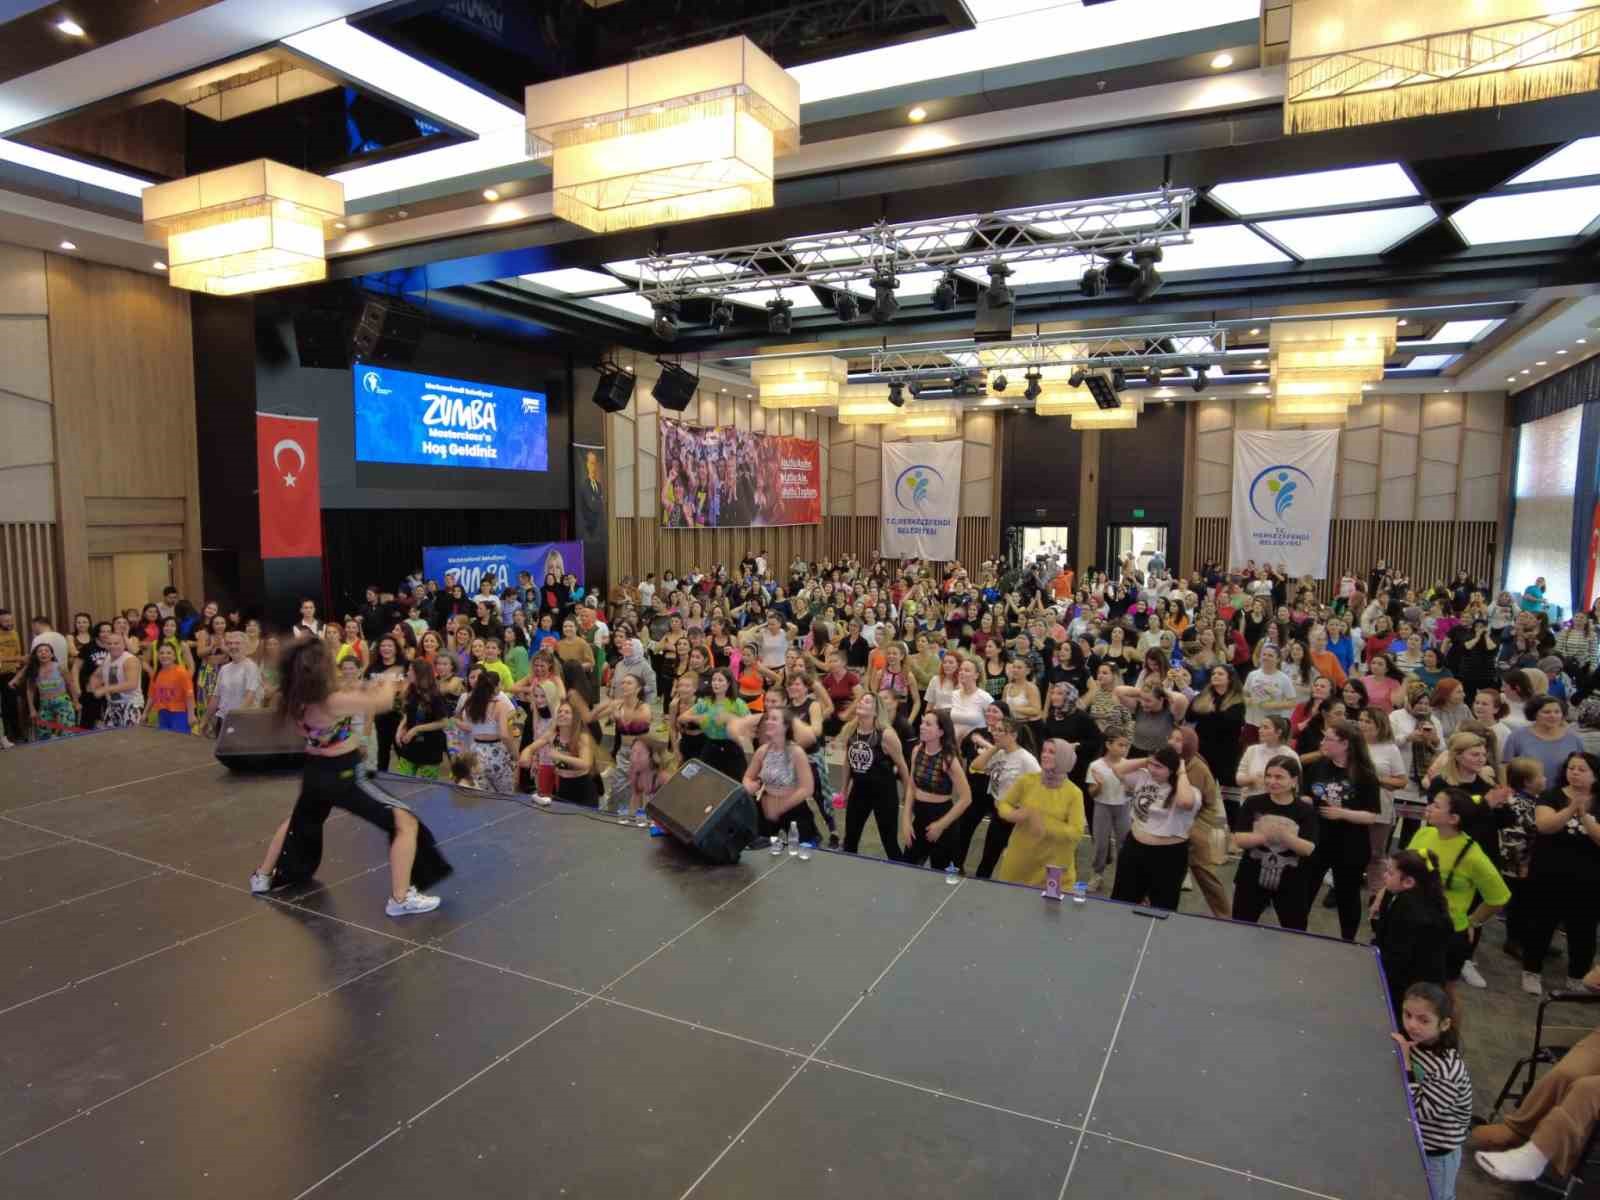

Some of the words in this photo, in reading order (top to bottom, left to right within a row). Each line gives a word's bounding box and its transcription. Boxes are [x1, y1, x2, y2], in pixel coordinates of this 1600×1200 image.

[421, 394, 496, 432] ZUMBA
[422, 441, 447, 458] Hoş
[448, 443, 497, 458] Geldiniz
